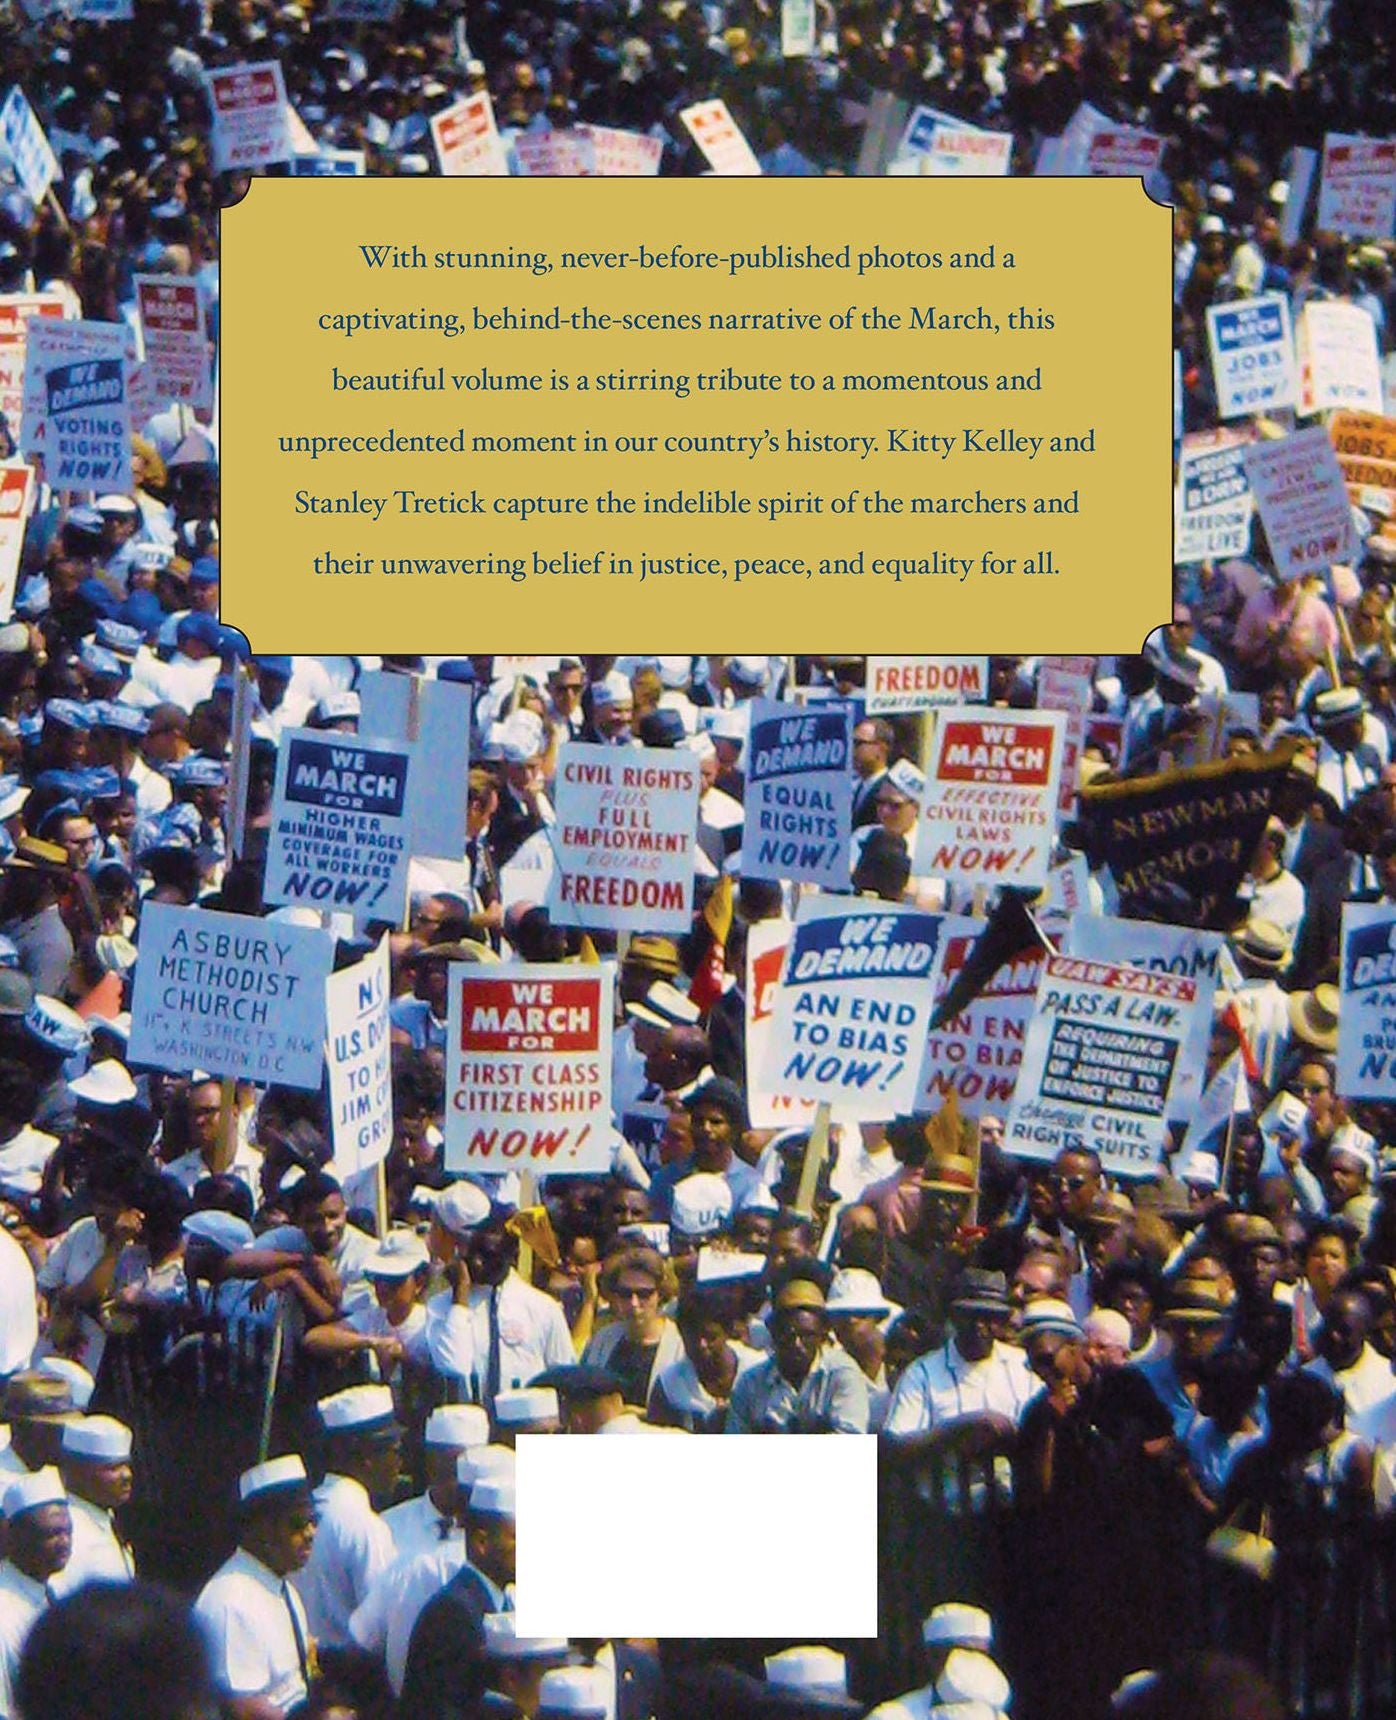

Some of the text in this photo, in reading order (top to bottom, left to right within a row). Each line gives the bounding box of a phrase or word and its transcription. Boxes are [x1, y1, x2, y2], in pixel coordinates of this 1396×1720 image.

[54, 416, 124, 436] VOTING
[59, 441, 122, 459] RIGHTS
[58, 460, 123, 480] NOW!
[874, 664, 982, 692] FREEDOM
[780, 718, 817, 743] WE
[981, 726, 1017, 745] WE
[332, 749, 366, 770] WE
[756, 739, 845, 774] DEMAND
[946, 744, 1045, 769] MARCH
[295, 765, 397, 799] MARCH
[565, 763, 693, 791] CIVIL RIGHTS
[974, 769, 1013, 782] FOR
[324, 794, 364, 809] FOR
[601, 789, 648, 806] PLUS
[763, 784, 835, 811] EQUAL
[942, 788, 1043, 806] EFFECTIVE
[306, 810, 381, 831] HIGHER
[599, 808, 652, 829] FULL
[760, 810, 838, 838] RIGHTS
[926, 806, 1047, 826] CIVIL RIGHTS
[1112, 786, 1271, 841] NEWMAN
[278, 820, 404, 850] MINIMUM WAGES
[563, 826, 689, 852] EMPLOYMENT
[956, 827, 1011, 841] LAWS
[283, 838, 398, 865] COVERAGE FOR
[759, 840, 840, 870] NOW!
[932, 846, 1035, 873] NOW!
[285, 853, 392, 879] ALL WORKERS
[283, 872, 389, 907] NOW!
[560, 872, 684, 910] FREEDOM
[840, 916, 897, 944] WE
[172, 928, 292, 966] ASBURY
[795, 942, 933, 978] DEMAND
[159, 955, 299, 999] METHODIST
[1050, 957, 1111, 986] UAW
[163, 986, 268, 1025] CHURCH
[512, 983, 553, 1004] WE
[1041, 990, 1103, 1015] PASS
[1103, 995, 1122, 1017] A
[470, 1006, 591, 1033] MARCH
[795, 991, 916, 1027] AN END
[203, 1022, 277, 1050] STREETS
[507, 1036, 555, 1050] FOR
[792, 1021, 908, 1056] TO BIAS
[1057, 1023, 1165, 1056] REQUIRING
[154, 1036, 250, 1066] WASHINGTON
[928, 1037, 1023, 1067] TO BIA
[1053, 1040, 1171, 1075] THE DEPARTMENT
[347, 1066, 370, 1092] TO
[460, 1063, 600, 1085] FIRST CLASS
[784, 1053, 904, 1091] NOW!
[1048, 1058, 1160, 1092] OF JUSTICE TO
[453, 1090, 602, 1113] CITIZENSHIP
[1044, 1076, 1105, 1104] ENFORCE
[341, 1094, 371, 1125] JIM
[467, 1123, 591, 1158] NOW!
[1091, 1114, 1146, 1139] CIVIL
[1012, 1122, 1152, 1161] RIGHTS SUITS
